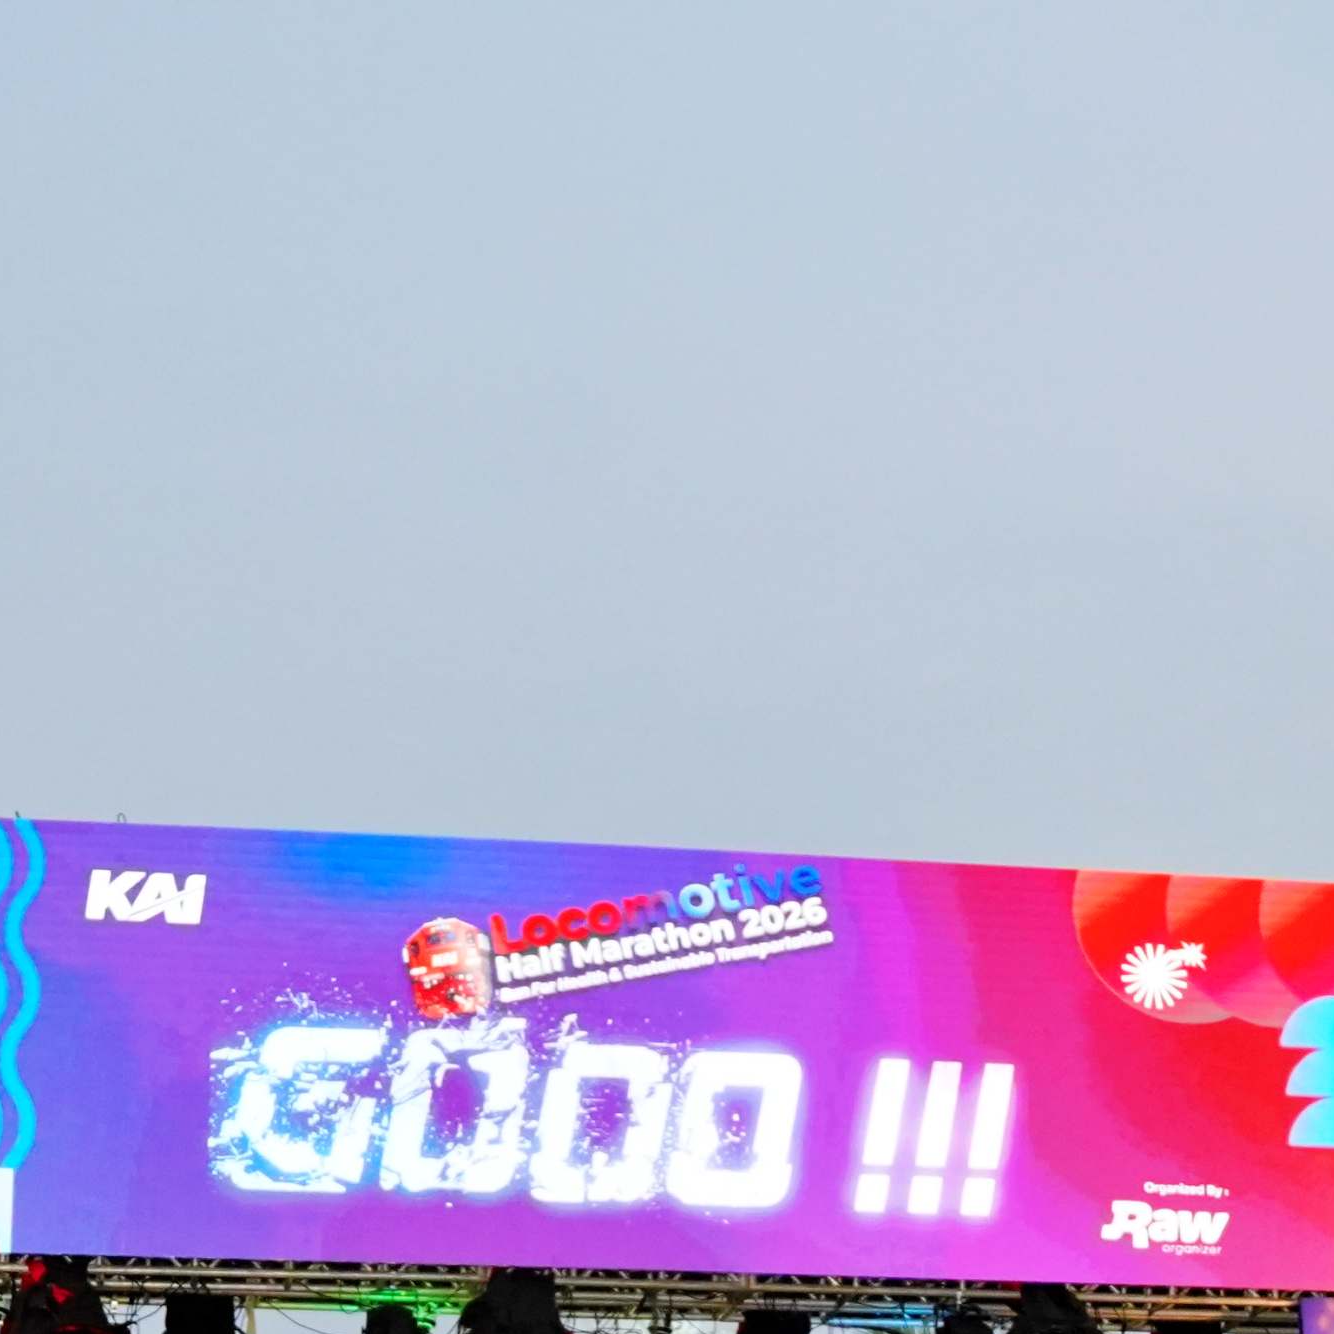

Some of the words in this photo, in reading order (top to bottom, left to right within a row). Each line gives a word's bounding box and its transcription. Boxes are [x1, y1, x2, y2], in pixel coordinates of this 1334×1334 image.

[85, 869, 207, 925] KAI
[490, 864, 822, 954] Locomotive
[495, 941, 567, 983] Half
[571, 916, 734, 969] Marathon
[738, 896, 828, 939] 2026
[1143, 1181, 1204, 1196] Organized
[1101, 1200, 1230, 1249] Raw
[1161, 1243, 1222, 1256] organizer
